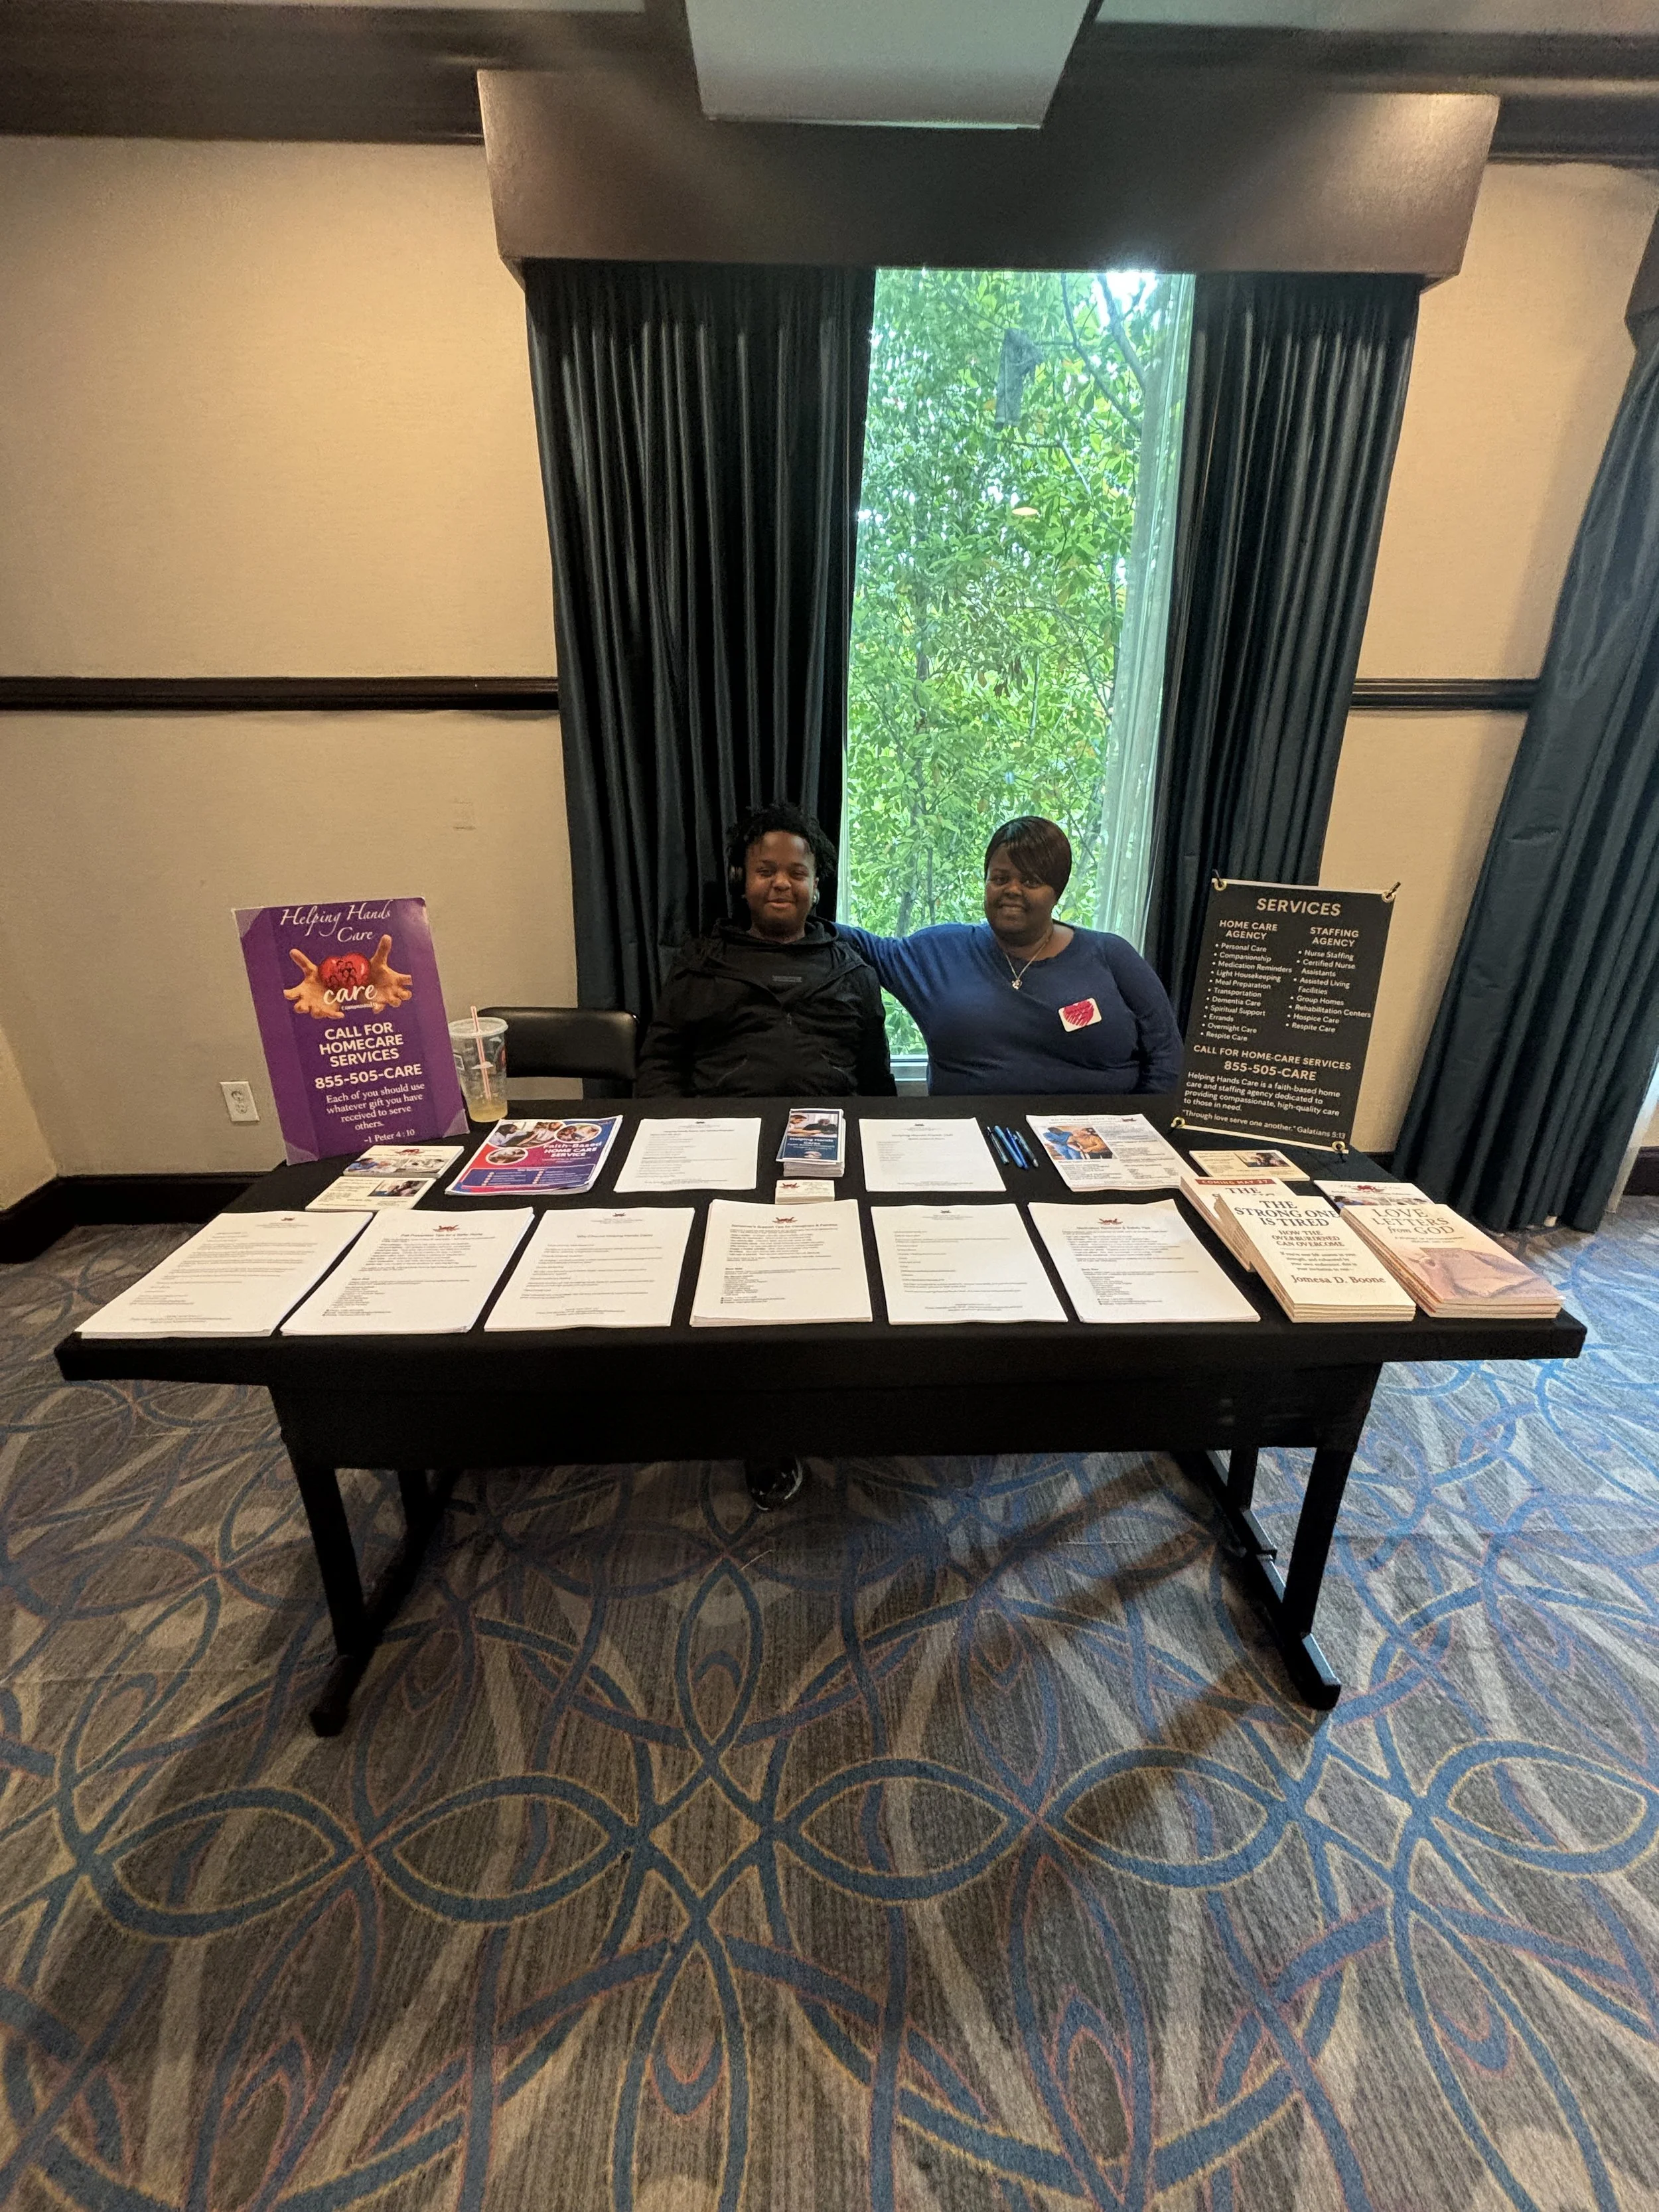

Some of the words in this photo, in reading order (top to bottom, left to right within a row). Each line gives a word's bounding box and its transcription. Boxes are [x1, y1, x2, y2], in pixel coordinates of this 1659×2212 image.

[1256, 897, 1341, 917] SERVICES
[280, 905, 342, 936] Helping
[346, 899, 393, 921] Hands
[1219, 919, 1249, 929] HOME
[1252, 922, 1278, 932] CARE
[337, 926, 373, 942] Care
[1225, 930, 1267, 940] AGENCY
[1310, 926, 1359, 938] STAFFING
[1221, 942, 1249, 951] Personal
[1312, 936, 1355, 948] AGENCY
[1220, 952, 1271, 963] Companionship
[1327, 951, 1354, 962] Staffing
[1218, 960, 1255, 969] Medication
[1256, 964, 1292, 973] Reminders
[1303, 958, 1333, 968] Certified
[1216, 970, 1233, 978] Light
[1234, 972, 1281, 983] Housekeeping
[1301, 968, 1336, 977] Assistants
[1232, 980, 1271, 990] Preparation
[1299, 977, 1329, 986] Assisted
[1330, 980, 1350, 990] Living
[323, 984, 378, 1005] care
[1214, 987, 1262, 997] Transportation
[1298, 986, 1328, 995] Facilities
[1212, 996, 1244, 1005] Dementia
[1296, 995, 1318, 1004] Group
[1210, 1005, 1238, 1013] Spiritual
[1239, 1007, 1265, 1017] Support
[1295, 1004, 1342, 1015] Rehabilitation
[1343, 1009, 1372, 1018] Centers
[1209, 1013, 1234, 1022] Errands
[1293, 1013, 1321, 1022] Hospice
[325, 1025, 362, 1041] CALL
[364, 1022, 394, 1035] FOR
[1208, 1022, 1240, 1032] Overnight
[1291, 1022, 1317, 1031] Respite
[1206, 1031, 1230, 1040] Respite
[319, 1033, 404, 1055] HOMECARE
[330, 1048, 399, 1067] SERVICES
[1193, 1045, 1217, 1055] CALL
[1220, 1047, 1239, 1057] FOR
[1241, 1050, 1301, 1064] HOME-CARE
[1303, 1057, 1352, 1070] SERVICES
[315, 1063, 423, 1089] 855-505-CARE
[1224, 1061, 1317, 1081] 855-505-CARE
[1188, 1071, 1215, 1082] Helping
[1216, 1075, 1240, 1084] Hands
[1241, 1078, 1259, 1087] Care
[1274, 1082, 1317, 1094] faith-based
[1319, 1088, 1340, 1098] home
[326, 1093, 349, 1104] Each
[350, 1090, 360, 1100] of
[362, 1090, 378, 1100] you
[380, 1083, 409, 1095] should
[410, 1082, 425, 1091] use
[1218, 1085, 1246, 1096] staffing
[1247, 1089, 1273, 1099] agency
[1274, 1092, 1313, 1104] dedicated
[326, 1102, 367, 1114] whatever
[369, 1098, 384, 1110] gift
[386, 1097, 402, 1107] you
[403, 1093, 423, 1102] have
[1185, 1090, 1218, 1100] providing
[1219, 1094, 1275, 1108] compassionate,
[1277, 1101, 1321, 1115] high-quality
[1192, 1098, 1212, 1107] those
[340, 1110, 377, 1123] received
[389, 1105, 411, 1114] serve
[354, 1120, 384, 1131] others.
[1182, 1109, 1213, 1121] "Through
[1297, 1126, 1330, 1138] Galatians
[374, 1132, 394, 1142] Peter
[1259, 1201, 1297, 1209] THE
[1234, 1207, 1301, 1218] STRONG
[1305, 1210, 1341, 1218] ONE
[1372, 1208, 1429, 1218] LOVE
[1260, 1217, 1276, 1226] IS
[1280, 1218, 1329, 1227] TIRED
[1371, 1217, 1449, 1225] LETTERS
[1291, 1275, 1331, 1284] Jomesa
